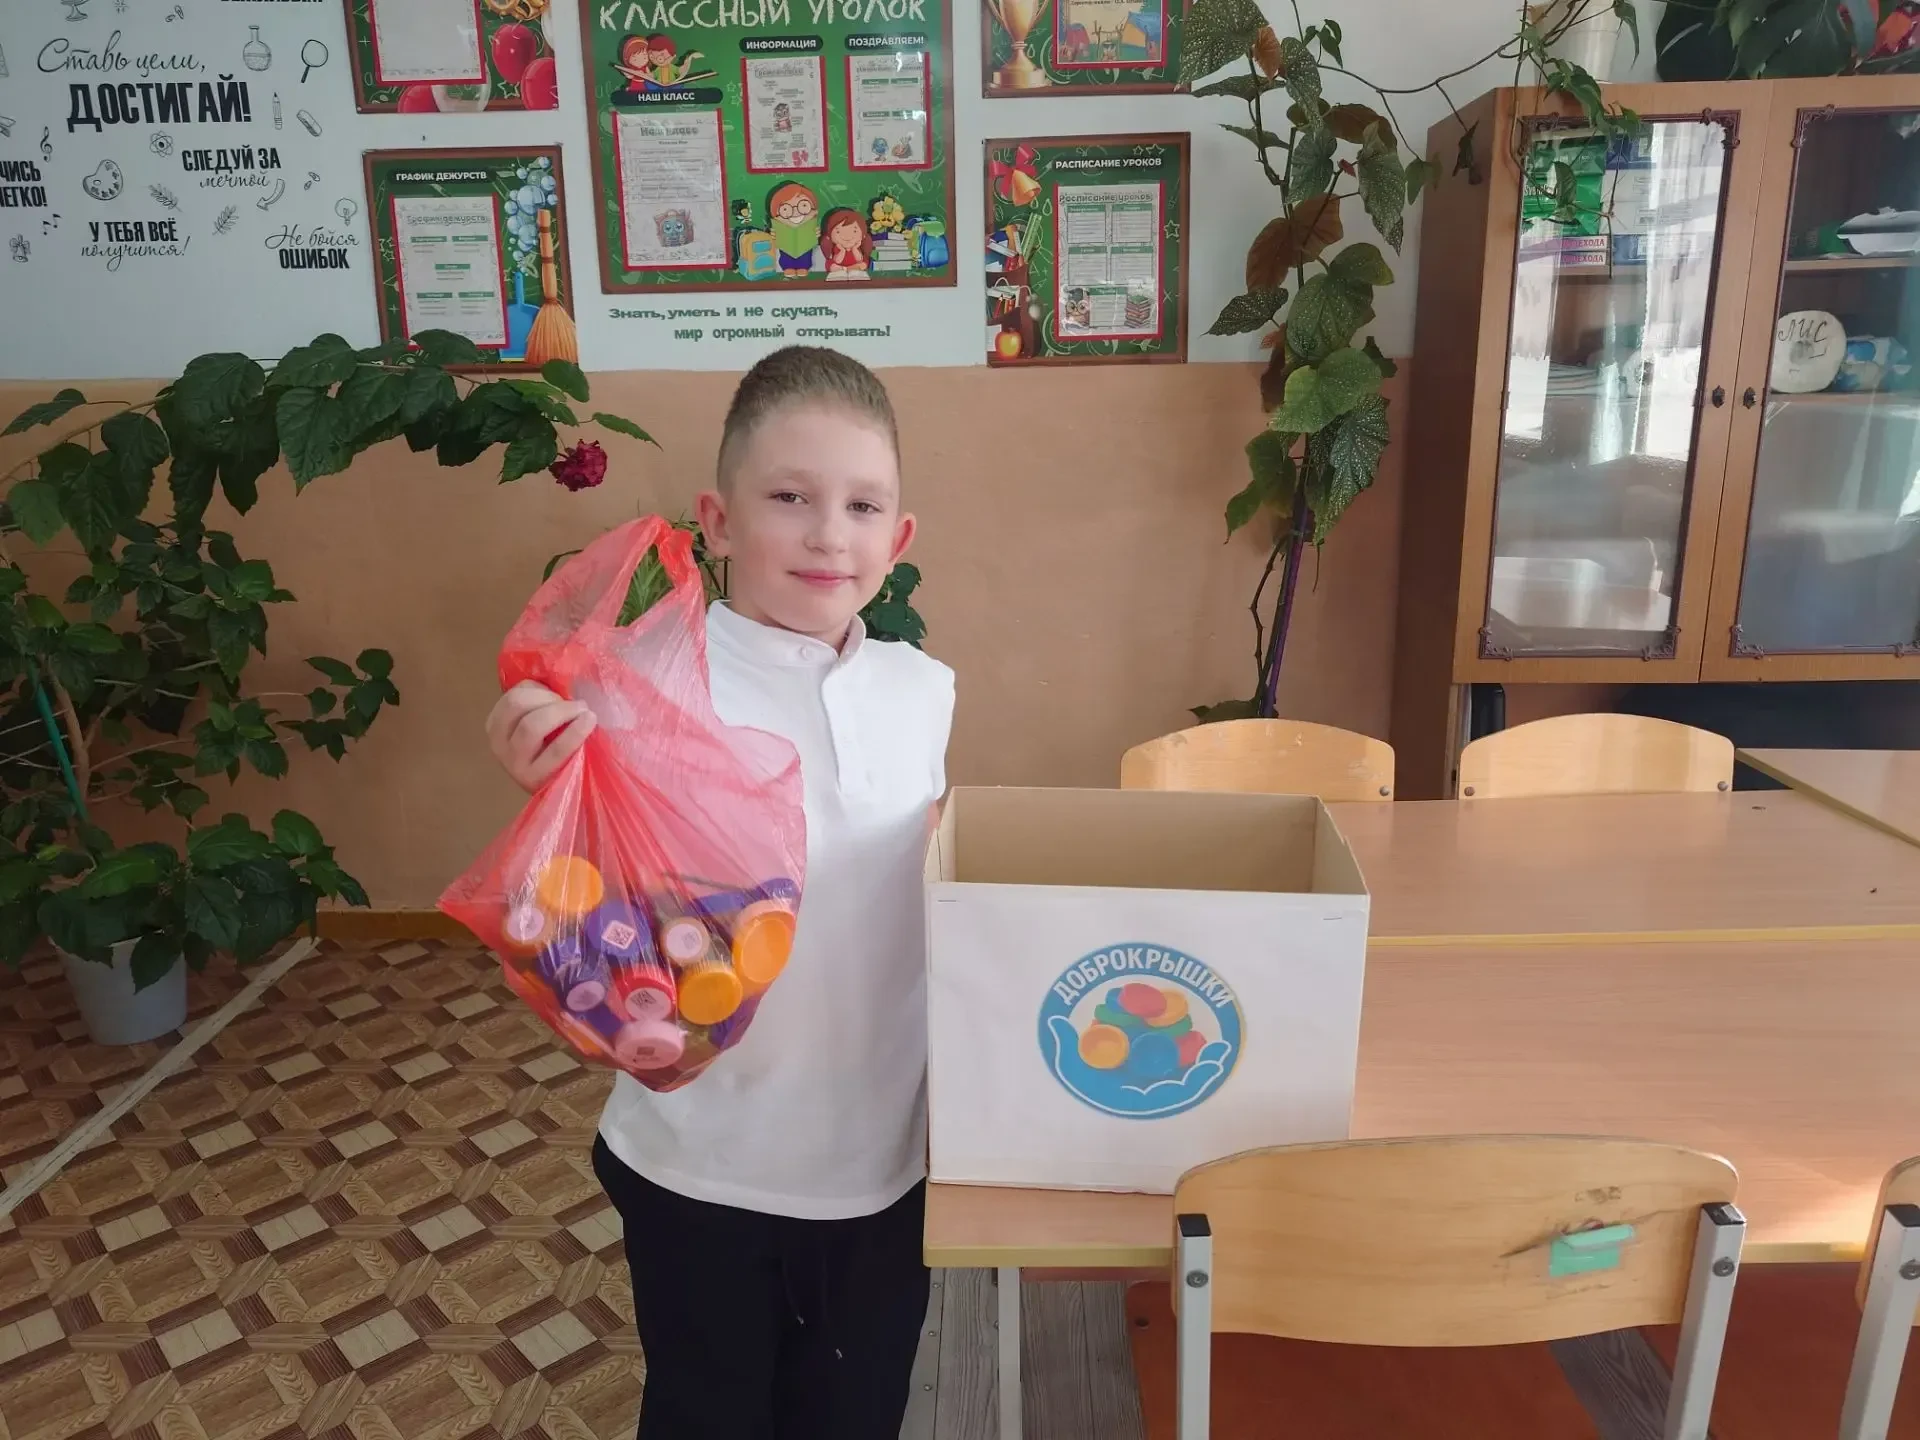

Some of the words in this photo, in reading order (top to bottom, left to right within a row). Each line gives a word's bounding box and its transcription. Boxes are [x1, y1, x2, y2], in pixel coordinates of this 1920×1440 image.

[600, 0, 791, 31] КЛАССНЫЙ
[807, 0, 926, 24] УГОЛОК
[746, 40, 817, 49] ИНФОРМАЦИЯ
[848, 36, 924, 47] ПОЗДРАВЛЯЕМ!
[37, 30, 131, 73] Ставь
[136, 53, 206, 77] цели,
[67, 73, 252, 133] ДОСТИГАЙ!
[638, 93, 661, 102] НАШ
[663, 92, 696, 101] КЛАСС
[181, 144, 255, 175] СЛЕДУЙ
[258, 147, 281, 169] ЗА
[1055, 159, 1121, 169] РАСПИСАНИЕ
[1123, 158, 1162, 167] УРОКОВ
[200, 171, 270, 188] мечтой
[396, 172, 434, 181] ГРАФИК
[435, 171, 487, 181] ДЕЖУРСТВ
[88, 221, 99, 242] У
[103, 221, 146, 242] ТЕБЯ
[148, 217, 179, 242] ВСЁ
[264, 223, 305, 249] Не
[309, 226, 360, 248] бойся
[81, 236, 191, 272] получится!
[279, 247, 350, 270] ОШИБОК
[608, 307, 666, 321] Знать,
[667, 308, 721, 320] уметь
[726, 306, 737, 317] и
[744, 306, 764, 317] не
[771, 305, 838, 320] скучать,
[674, 329, 703, 342] мир
[713, 324, 785, 341] огромный
[795, 325, 891, 338] открывать!
[1053, 947, 1235, 1009] ДОБРОКРЫШКИ
